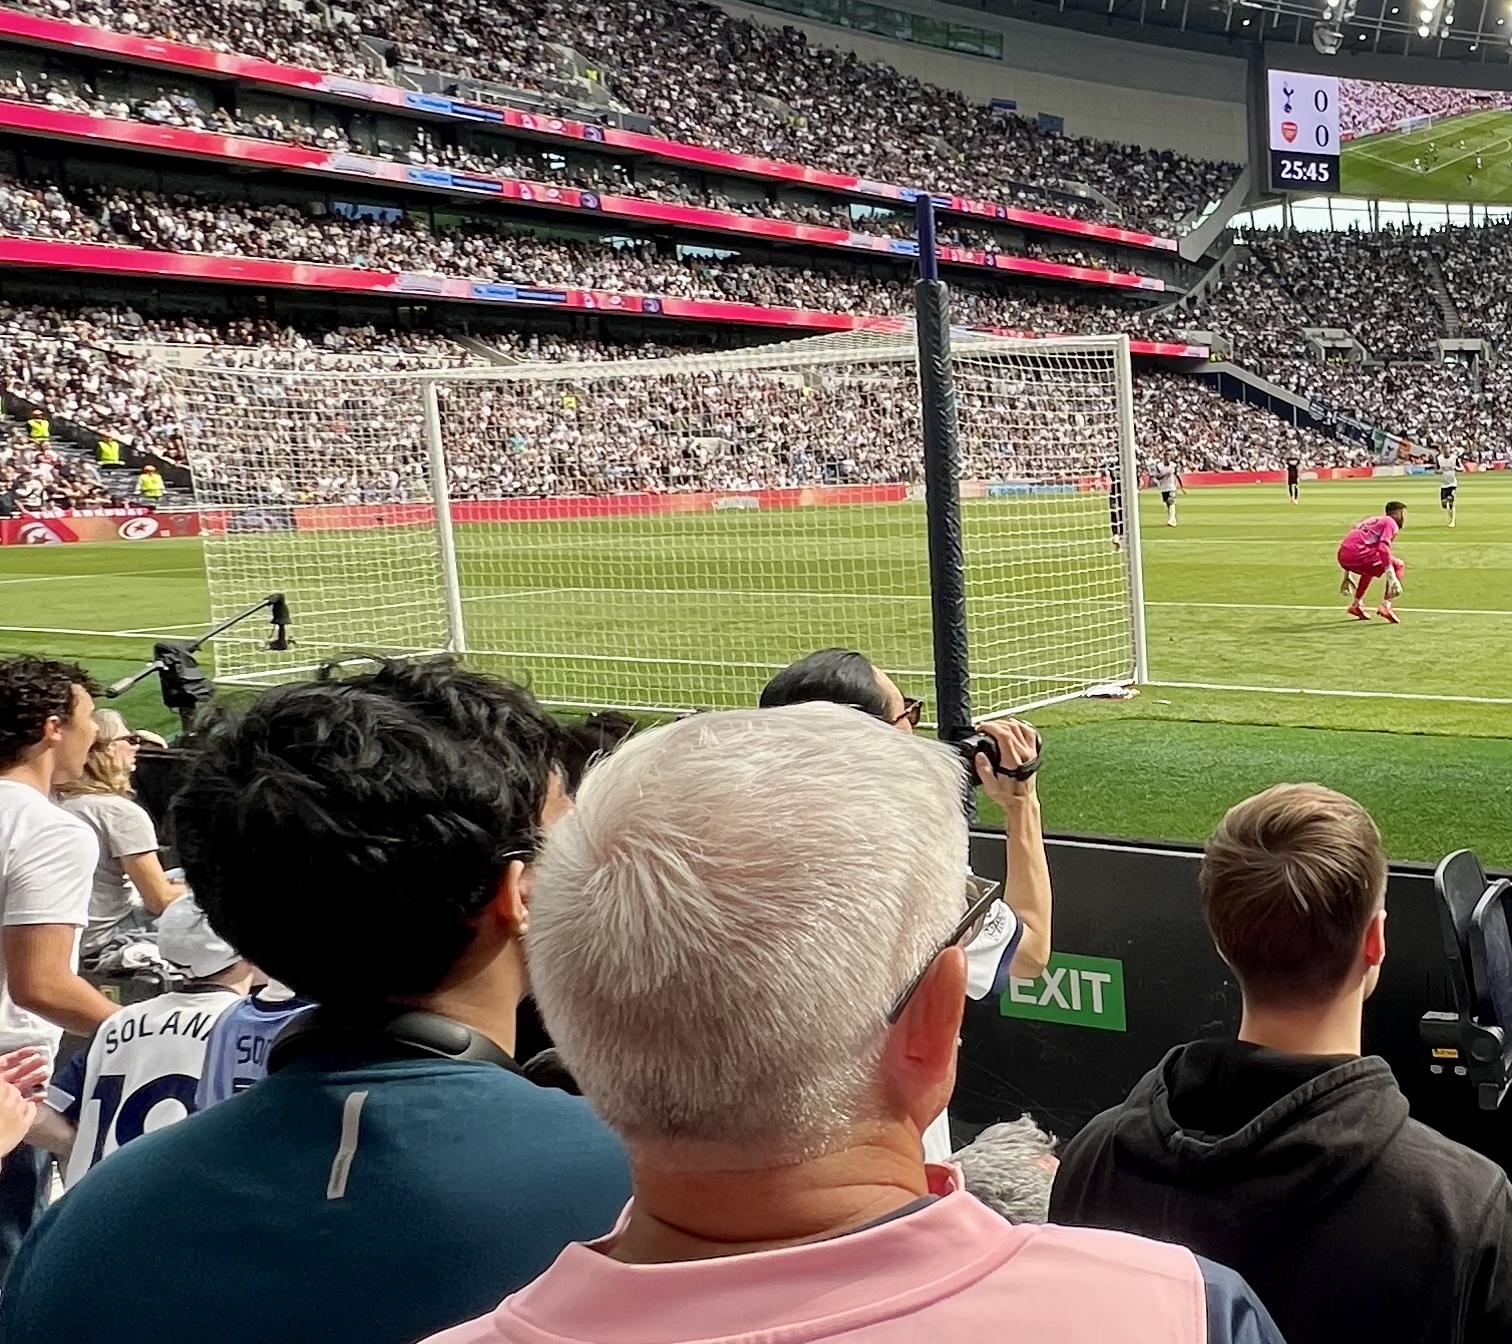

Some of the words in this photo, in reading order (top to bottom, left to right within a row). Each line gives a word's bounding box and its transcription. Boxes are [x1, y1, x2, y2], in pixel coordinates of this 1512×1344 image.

[1314, 89, 1328, 112] 0
[1315, 124, 1329, 147] 0
[1280, 159, 1330, 182] 25:45
[1009, 967, 1112, 1014] EXIT
[236, 1035, 273, 1066] SO
